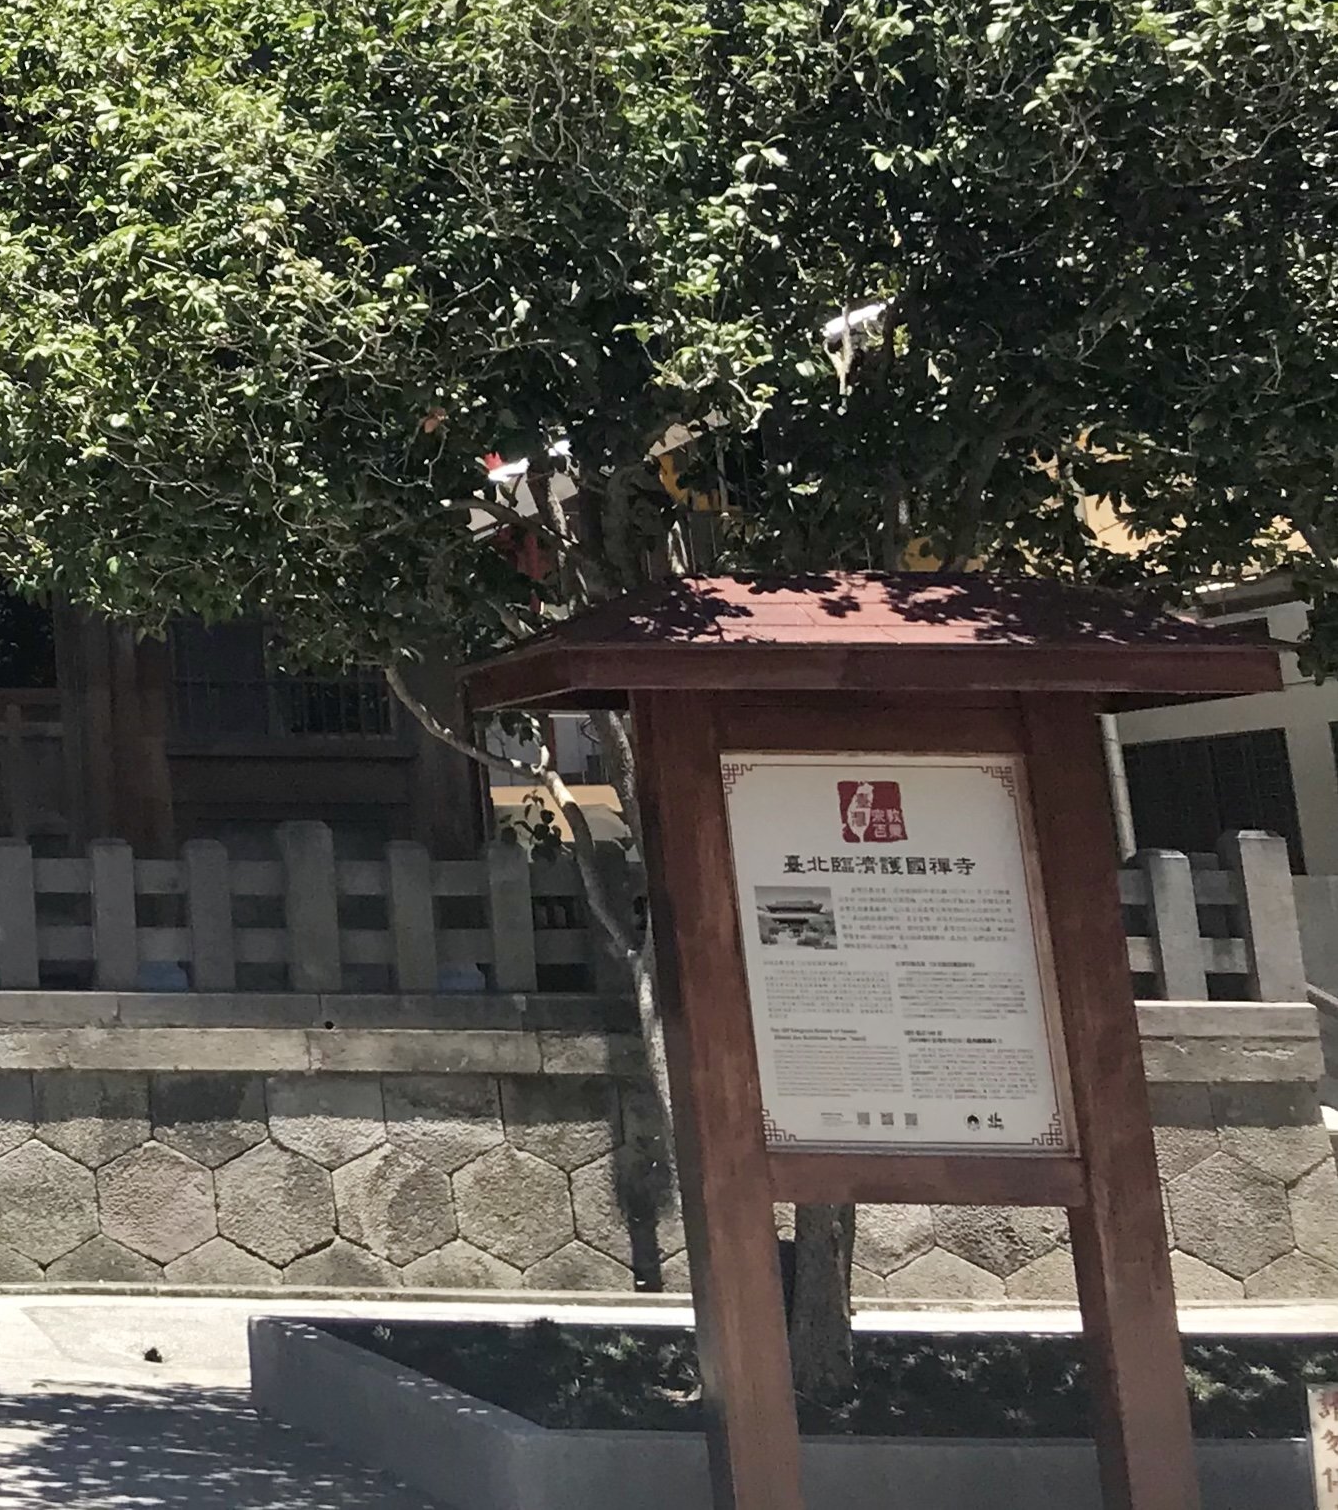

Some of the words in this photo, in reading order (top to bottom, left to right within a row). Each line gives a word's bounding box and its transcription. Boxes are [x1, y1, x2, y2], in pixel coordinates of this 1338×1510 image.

[783, 854, 976, 876] 臺北臨濟護國禪寺
